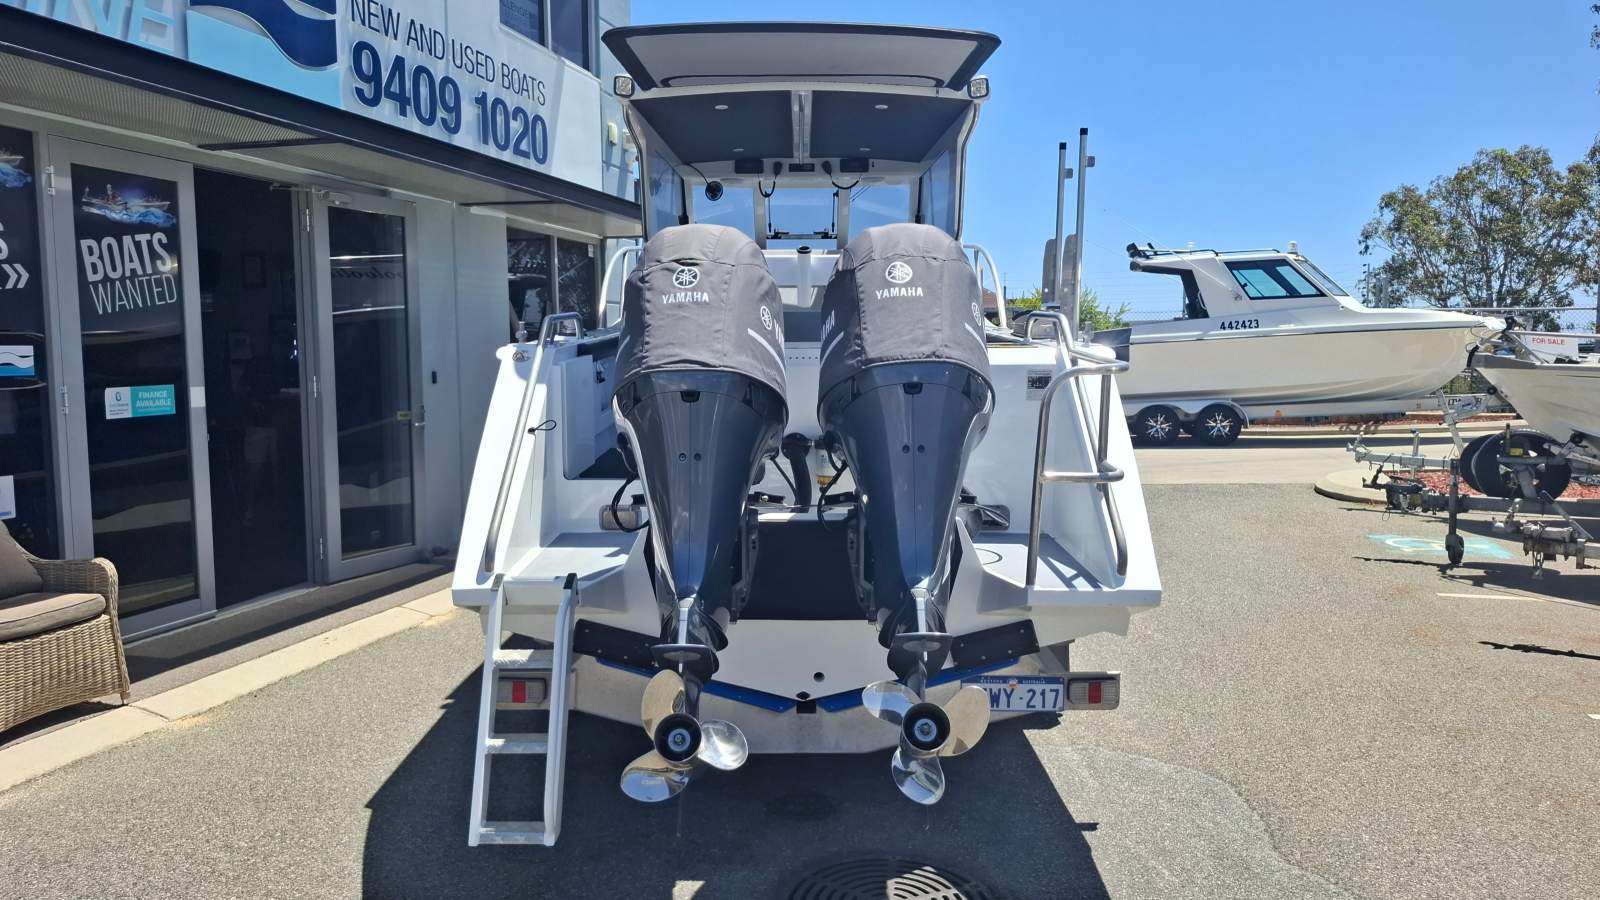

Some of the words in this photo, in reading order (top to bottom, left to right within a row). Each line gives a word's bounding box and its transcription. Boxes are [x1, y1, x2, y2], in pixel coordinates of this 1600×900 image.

[351, 0, 401, 41] NEW
[406, 18, 446, 61] AND
[451, 38, 496, 84] USED
[501, 61, 546, 107] BOATS
[352, 40, 463, 136] 9409
[474, 90, 549, 166] 1020
[80, 231, 173, 282] BOATS
[88, 272, 178, 316] WANTED
[661, 291, 710, 305] YAMAHA
[875, 286, 925, 301] YAMAHA
[1219, 318, 1260, 331] 442423
[1547, 337, 1567, 346] SALE
[139, 390, 168, 398] FINANCE
[136, 399, 171, 407] AVAILABLE
